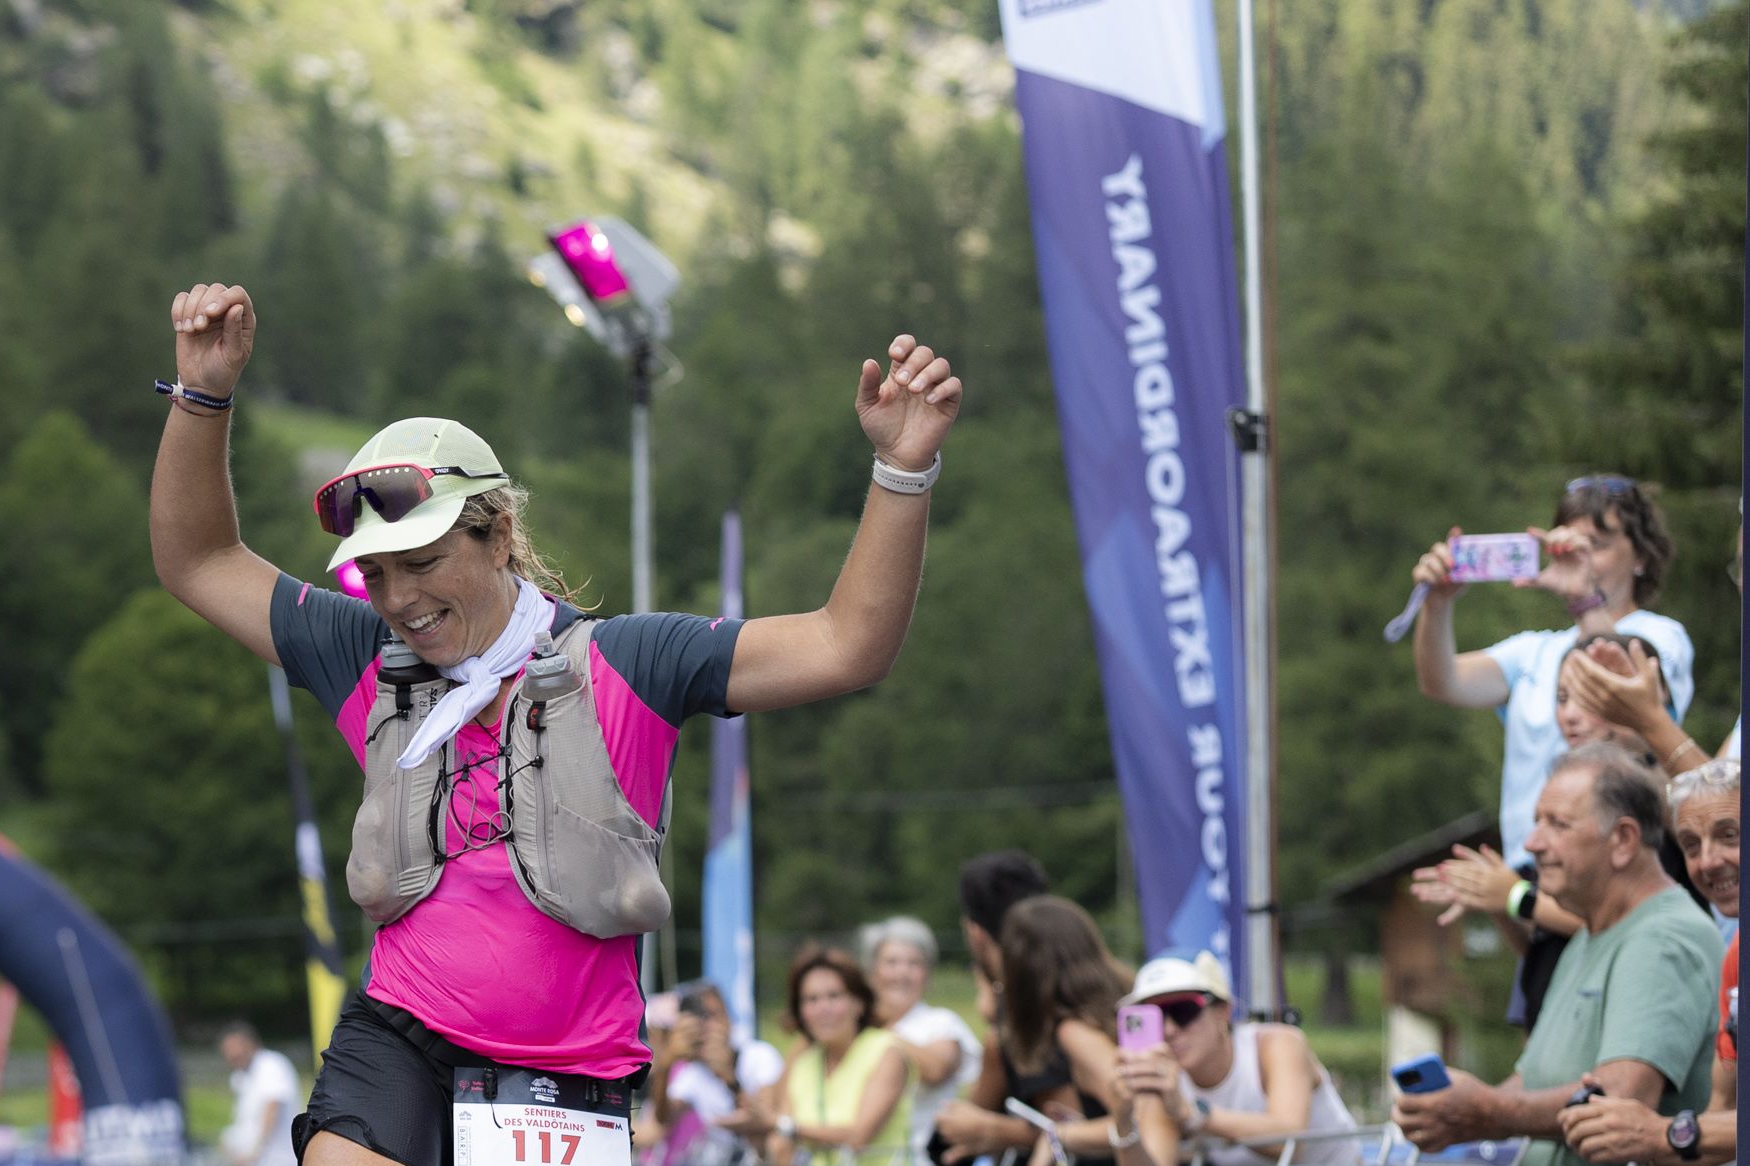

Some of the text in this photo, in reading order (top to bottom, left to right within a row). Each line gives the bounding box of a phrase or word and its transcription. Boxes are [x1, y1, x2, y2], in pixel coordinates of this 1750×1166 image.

[524, 1108, 567, 1119] SENTIERS
[504, 1118, 523, 1127] DES
[526, 1118, 585, 1132] VALDÔTAINS
[513, 1130, 581, 1165] 117
